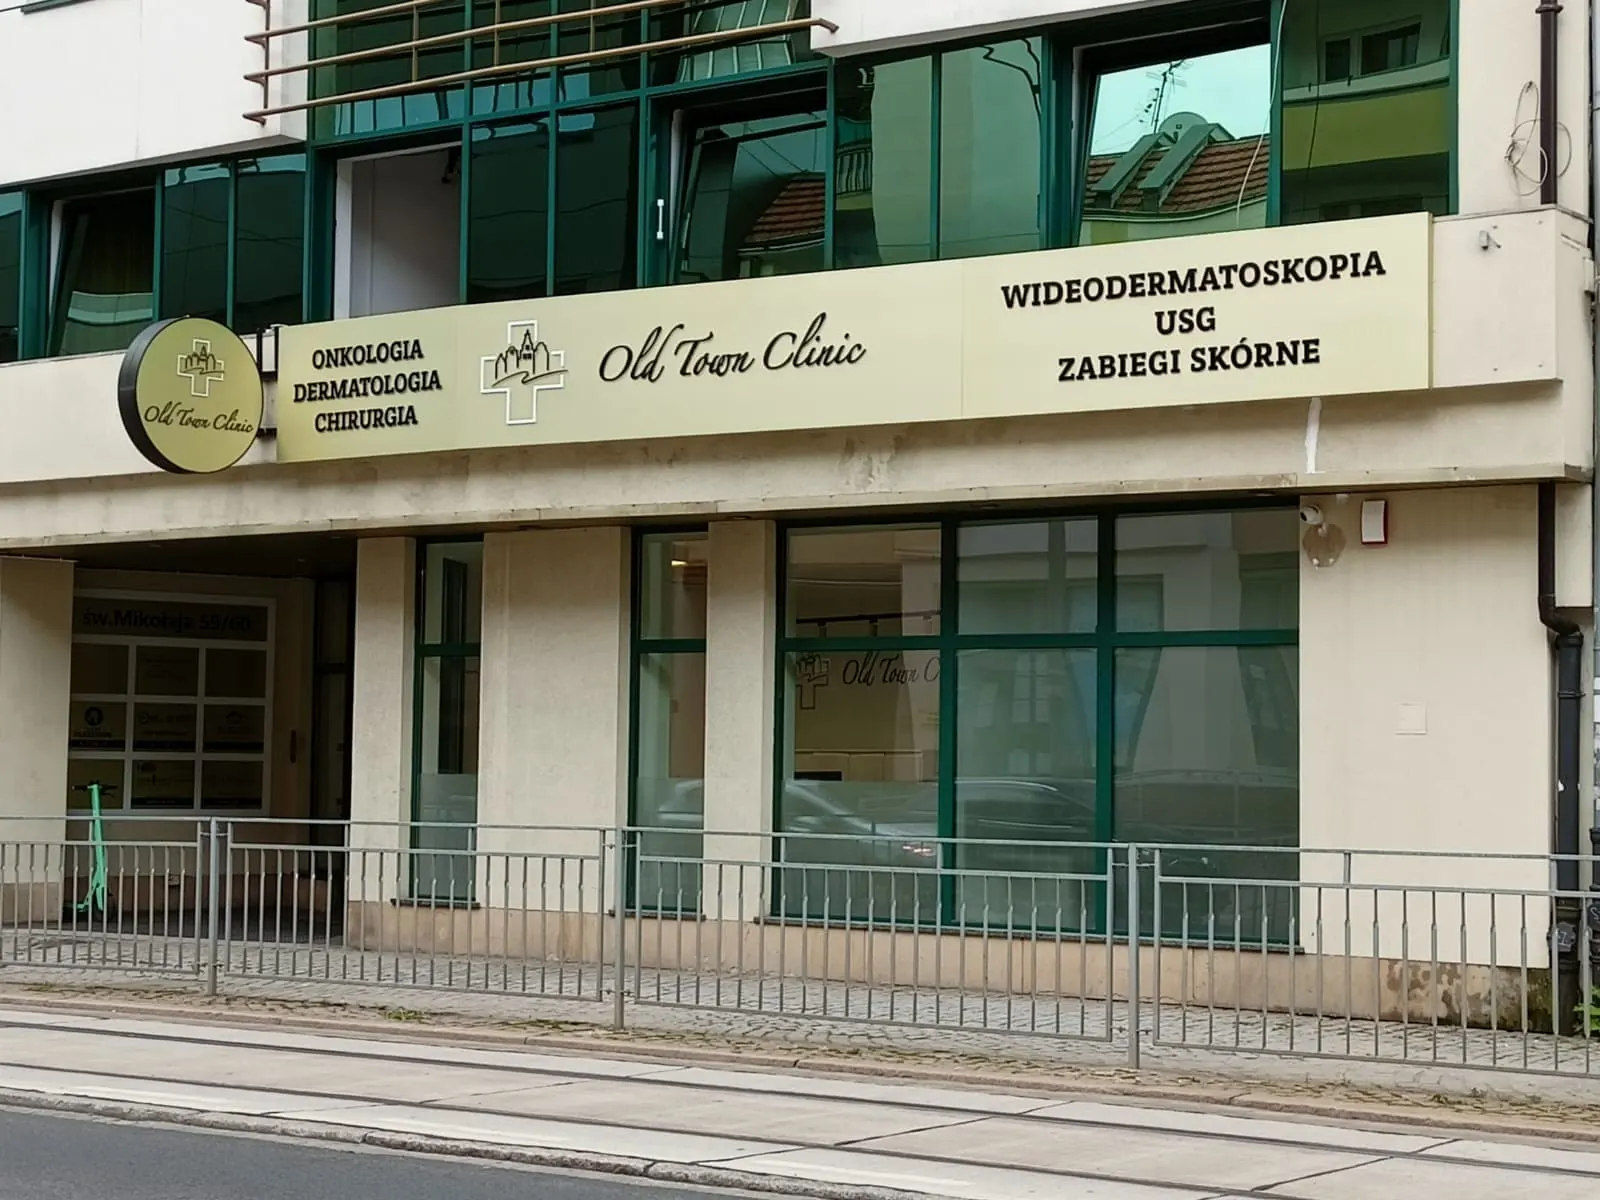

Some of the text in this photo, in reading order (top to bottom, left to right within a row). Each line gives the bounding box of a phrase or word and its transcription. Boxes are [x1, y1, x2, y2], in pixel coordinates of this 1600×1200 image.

[1001, 250, 1386, 308] WIDEODERMATOSKOPIA
[1154, 306, 1217, 335] USG
[311, 338, 424, 369] ONKOLOGIA
[599, 312, 868, 383] Old Town Clinic
[1057, 337, 1321, 382] ZABIEGI SKÓRNE
[293, 369, 442, 403] DERMATOLOGIA
[143, 400, 254, 434] Old Town Clinic
[314, 405, 419, 433] CHIRURGIA
[842, 650, 880, 687] Old
[879, 654, 920, 685] Town
